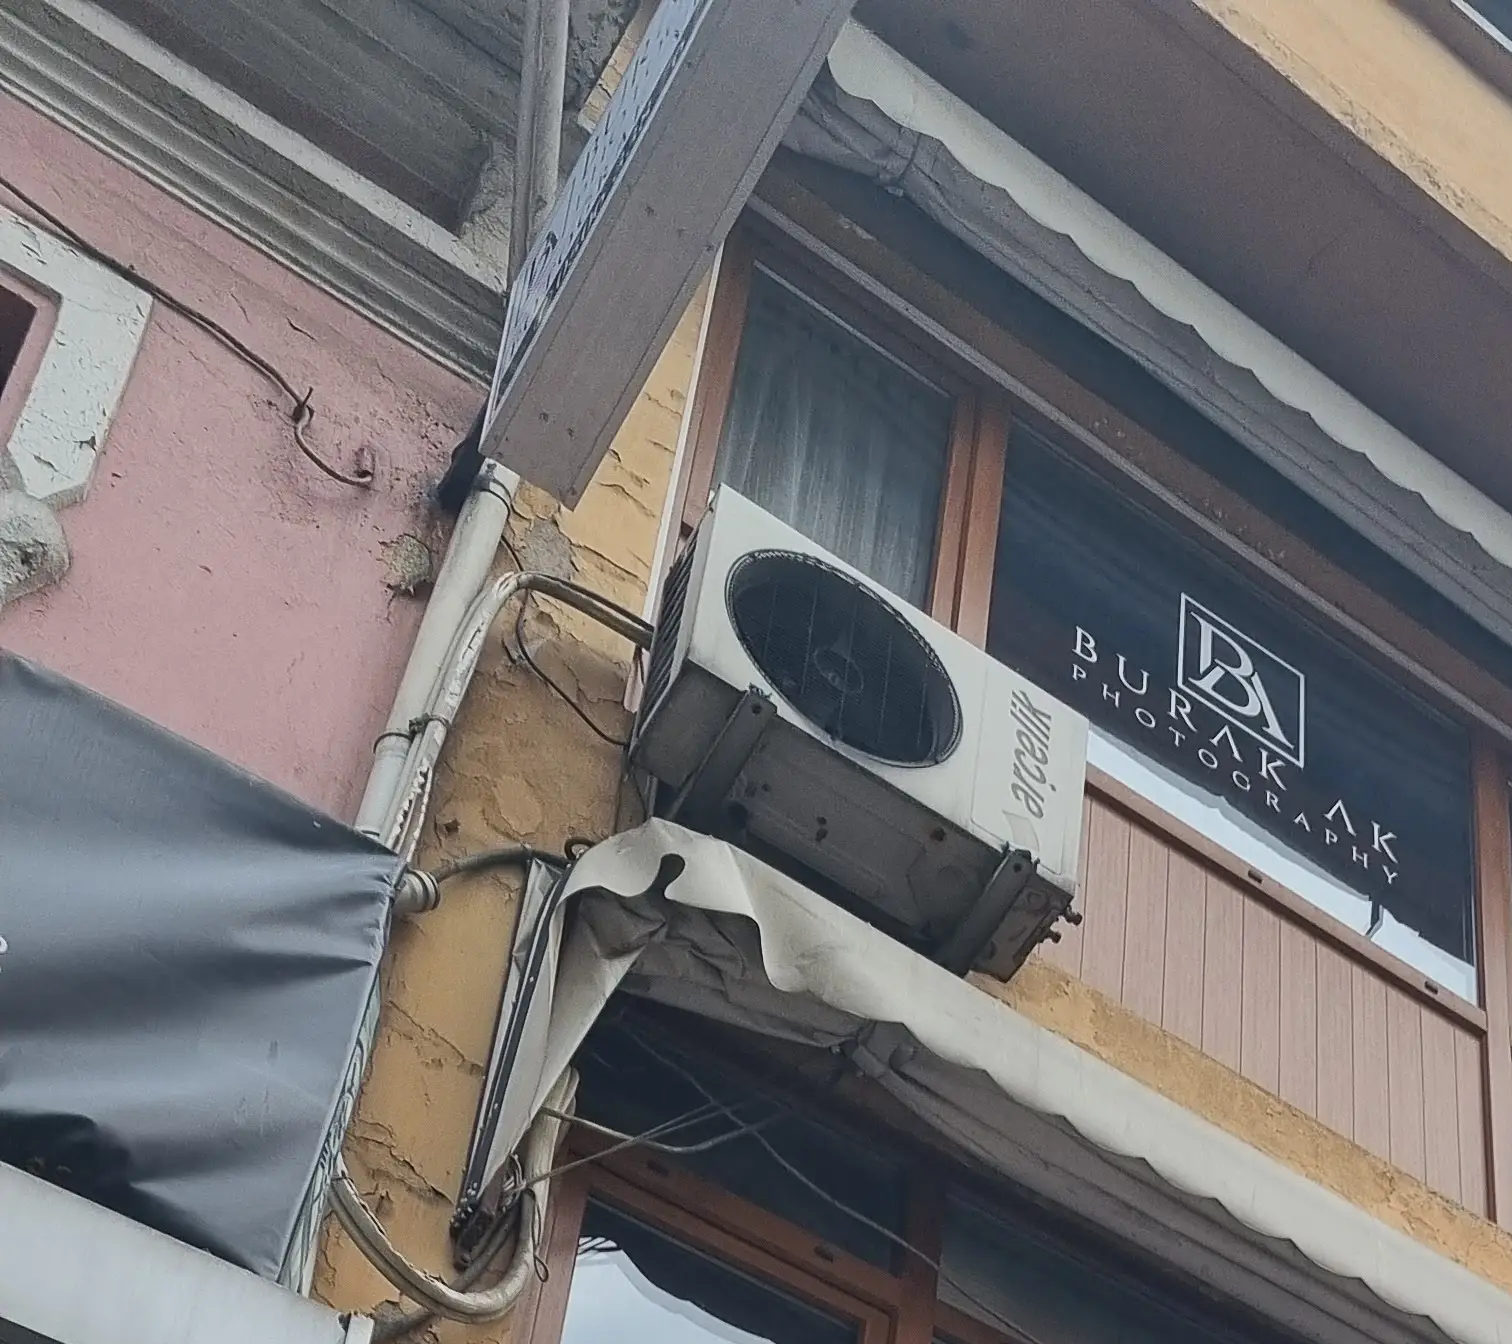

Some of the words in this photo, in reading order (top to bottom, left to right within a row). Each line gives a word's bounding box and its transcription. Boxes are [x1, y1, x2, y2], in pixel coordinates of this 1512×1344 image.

[1009, 689, 1057, 819] arçelik
[1071, 624, 1288, 791] BURAK
[1323, 799, 1398, 864] AK
[1071, 663, 1399, 885] PHOTOGRAPHY
